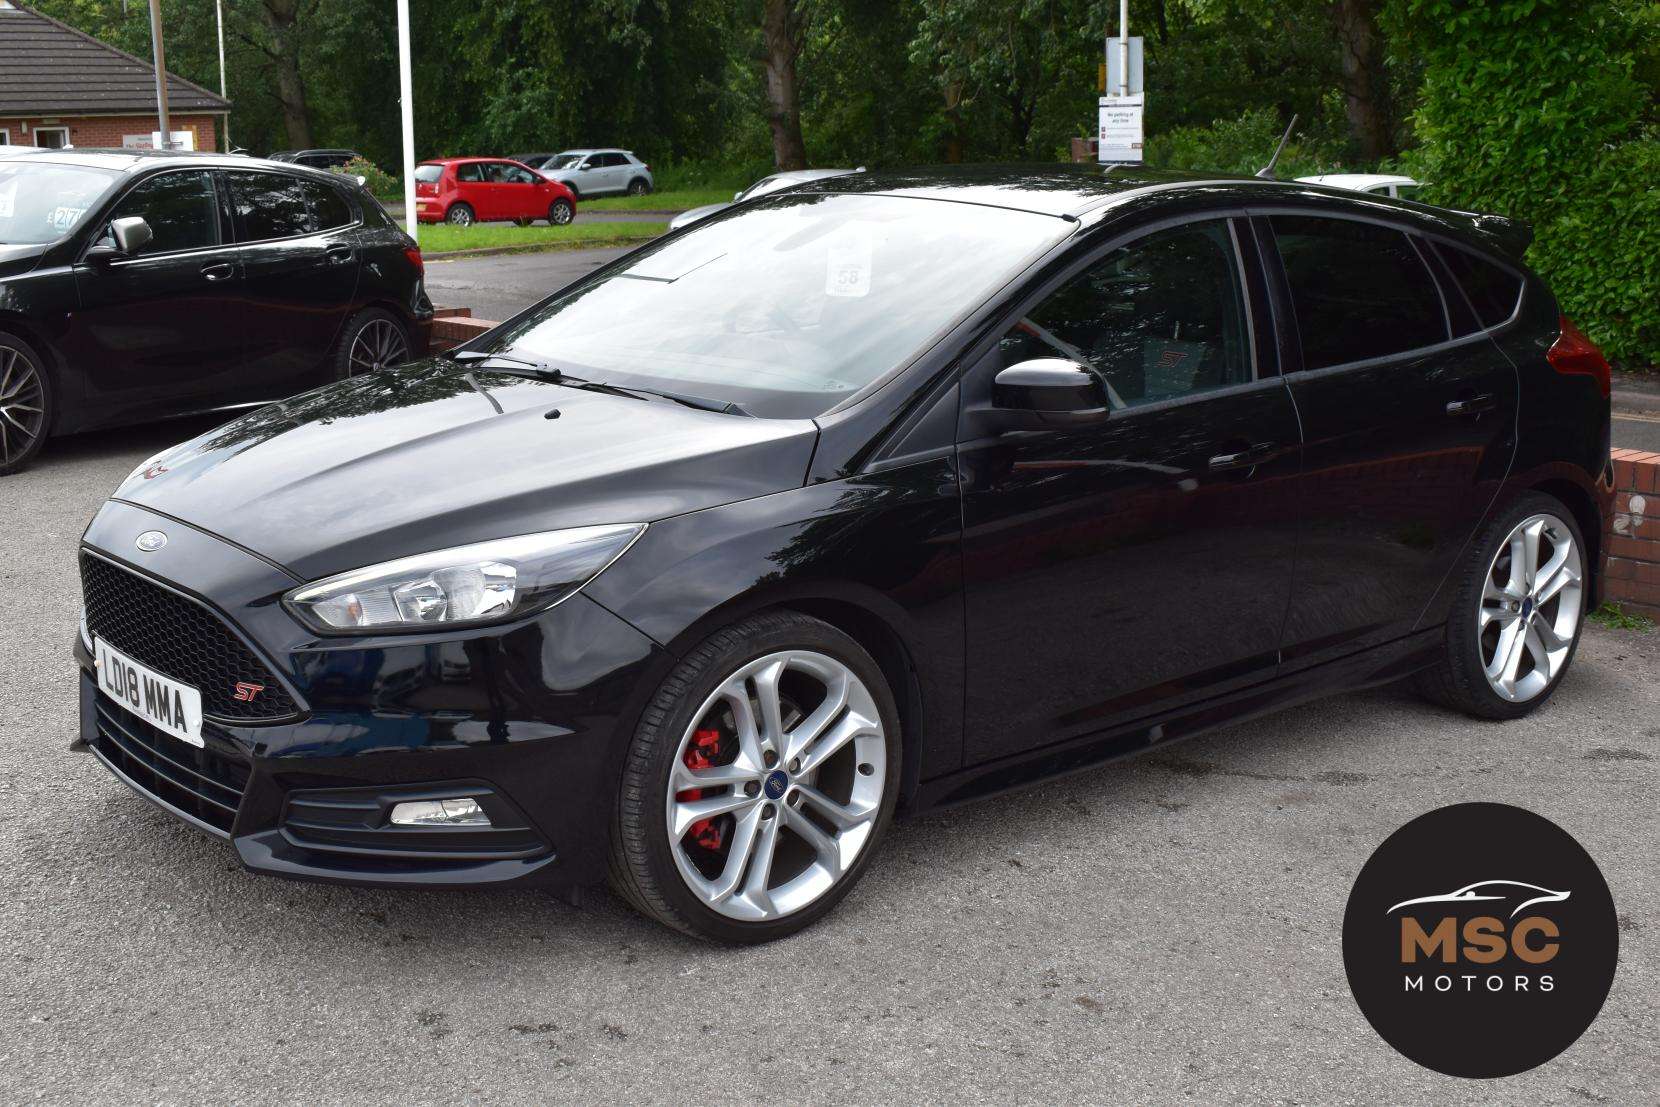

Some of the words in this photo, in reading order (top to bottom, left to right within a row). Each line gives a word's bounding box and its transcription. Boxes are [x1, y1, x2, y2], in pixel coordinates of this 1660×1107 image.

[838, 270, 859, 285] 58
[103, 649, 140, 708] LD18
[143, 674, 187, 733] MMA
[234, 681, 265, 701] ST
